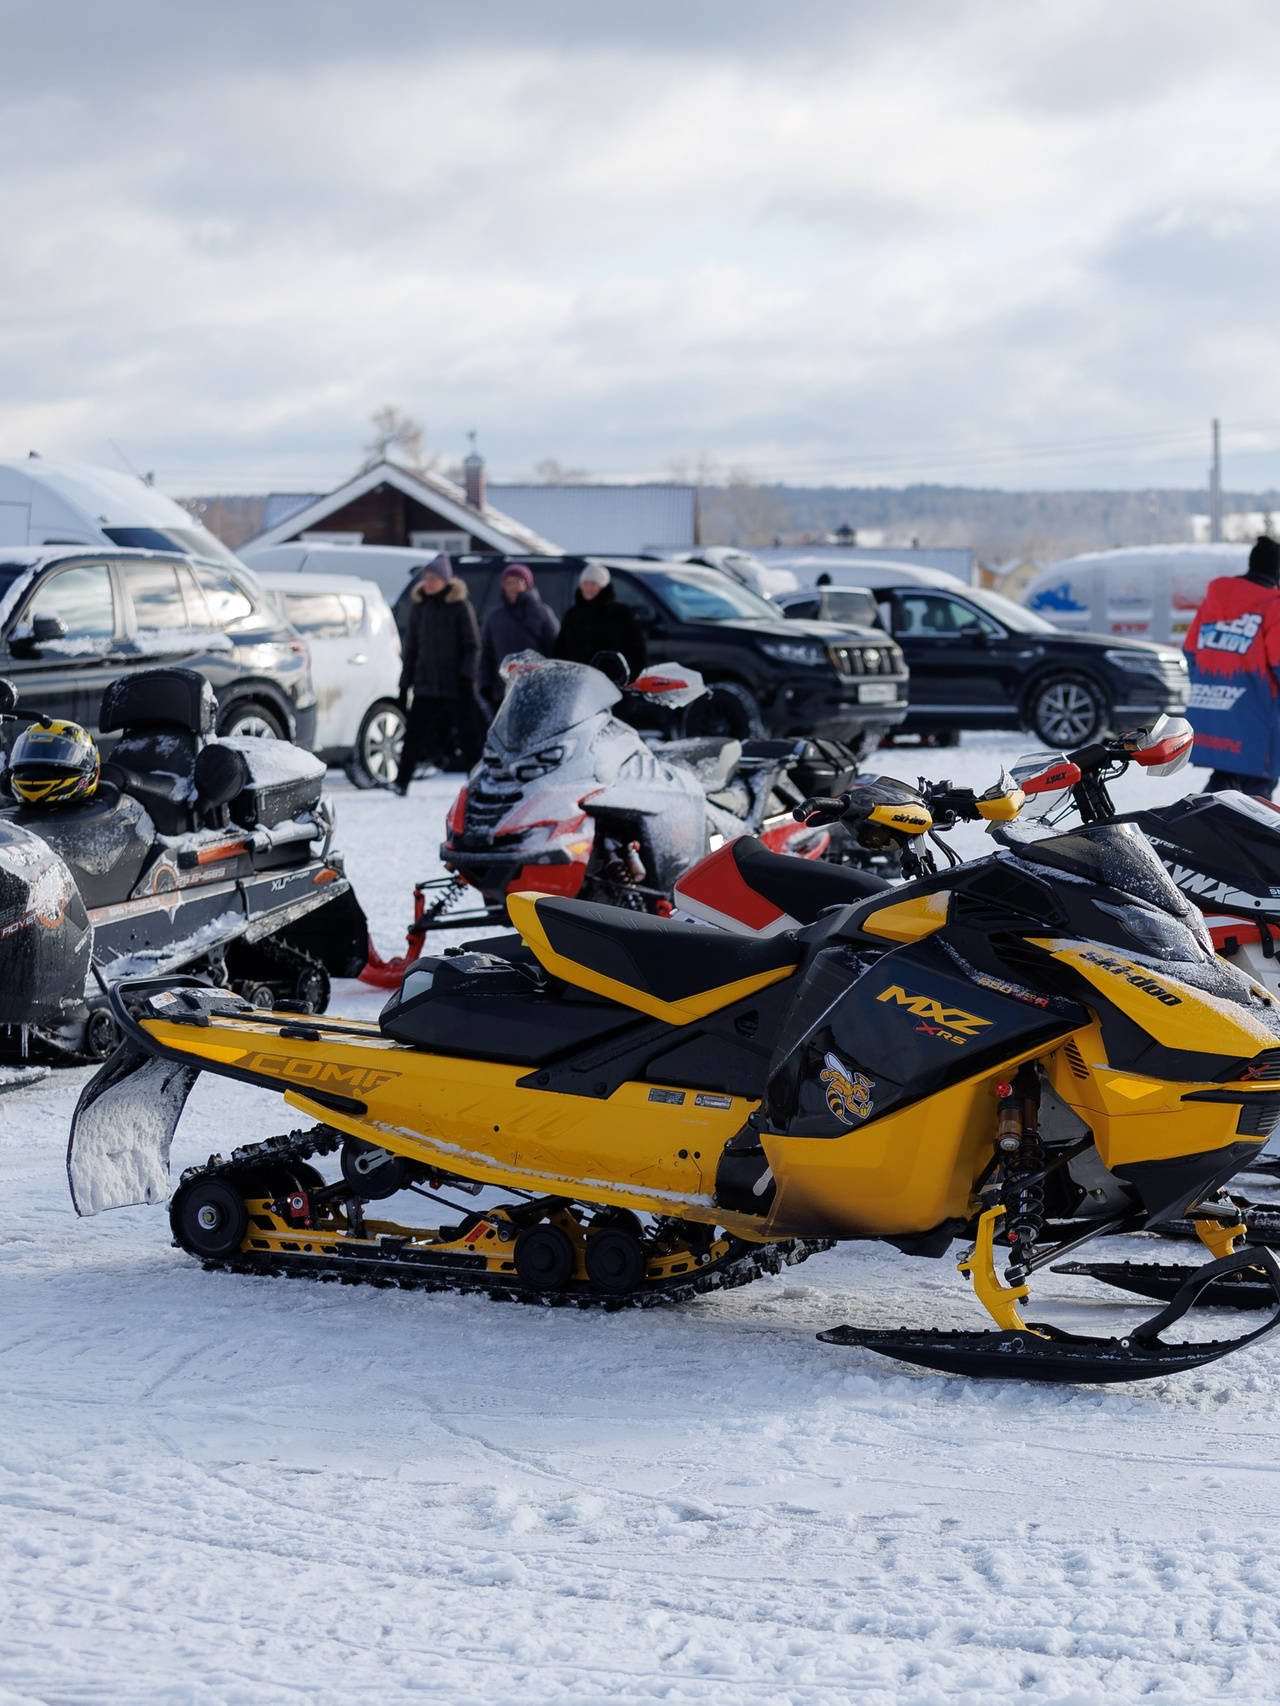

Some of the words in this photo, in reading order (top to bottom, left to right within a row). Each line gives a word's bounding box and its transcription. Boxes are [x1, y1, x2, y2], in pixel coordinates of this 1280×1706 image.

[1046, 772, 1067, 784] LYNX
[1078, 951, 1184, 1007] ski-doo
[875, 984, 995, 1036] MXZ
